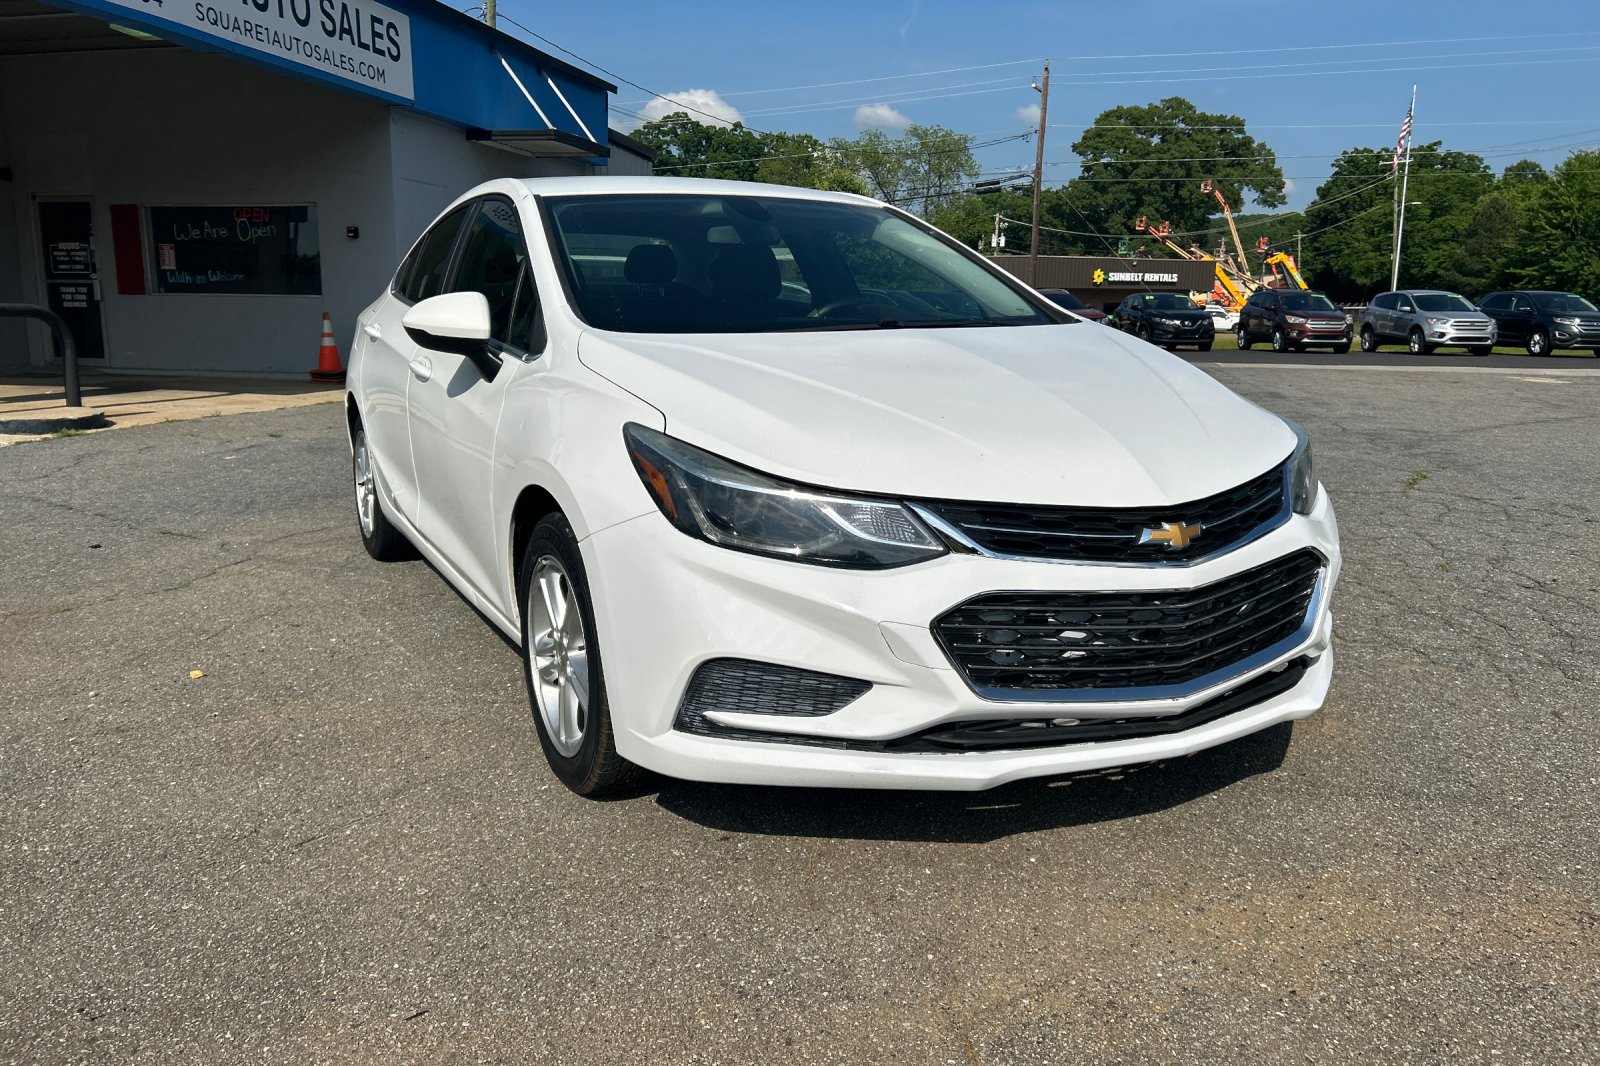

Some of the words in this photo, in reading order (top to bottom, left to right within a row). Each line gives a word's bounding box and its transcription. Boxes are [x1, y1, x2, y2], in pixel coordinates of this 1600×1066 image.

[195, 3, 386, 83] SQUARE1AUTOSALES.COM
[320, 0, 401, 62] SALES
[232, 207, 270, 222] OPEN
[174, 223, 201, 240] We
[204, 221, 229, 238] Are
[236, 218, 276, 244] Open
[1108, 272, 1143, 282] SUNBELT
[1144, 273, 1178, 282] RENTALS
